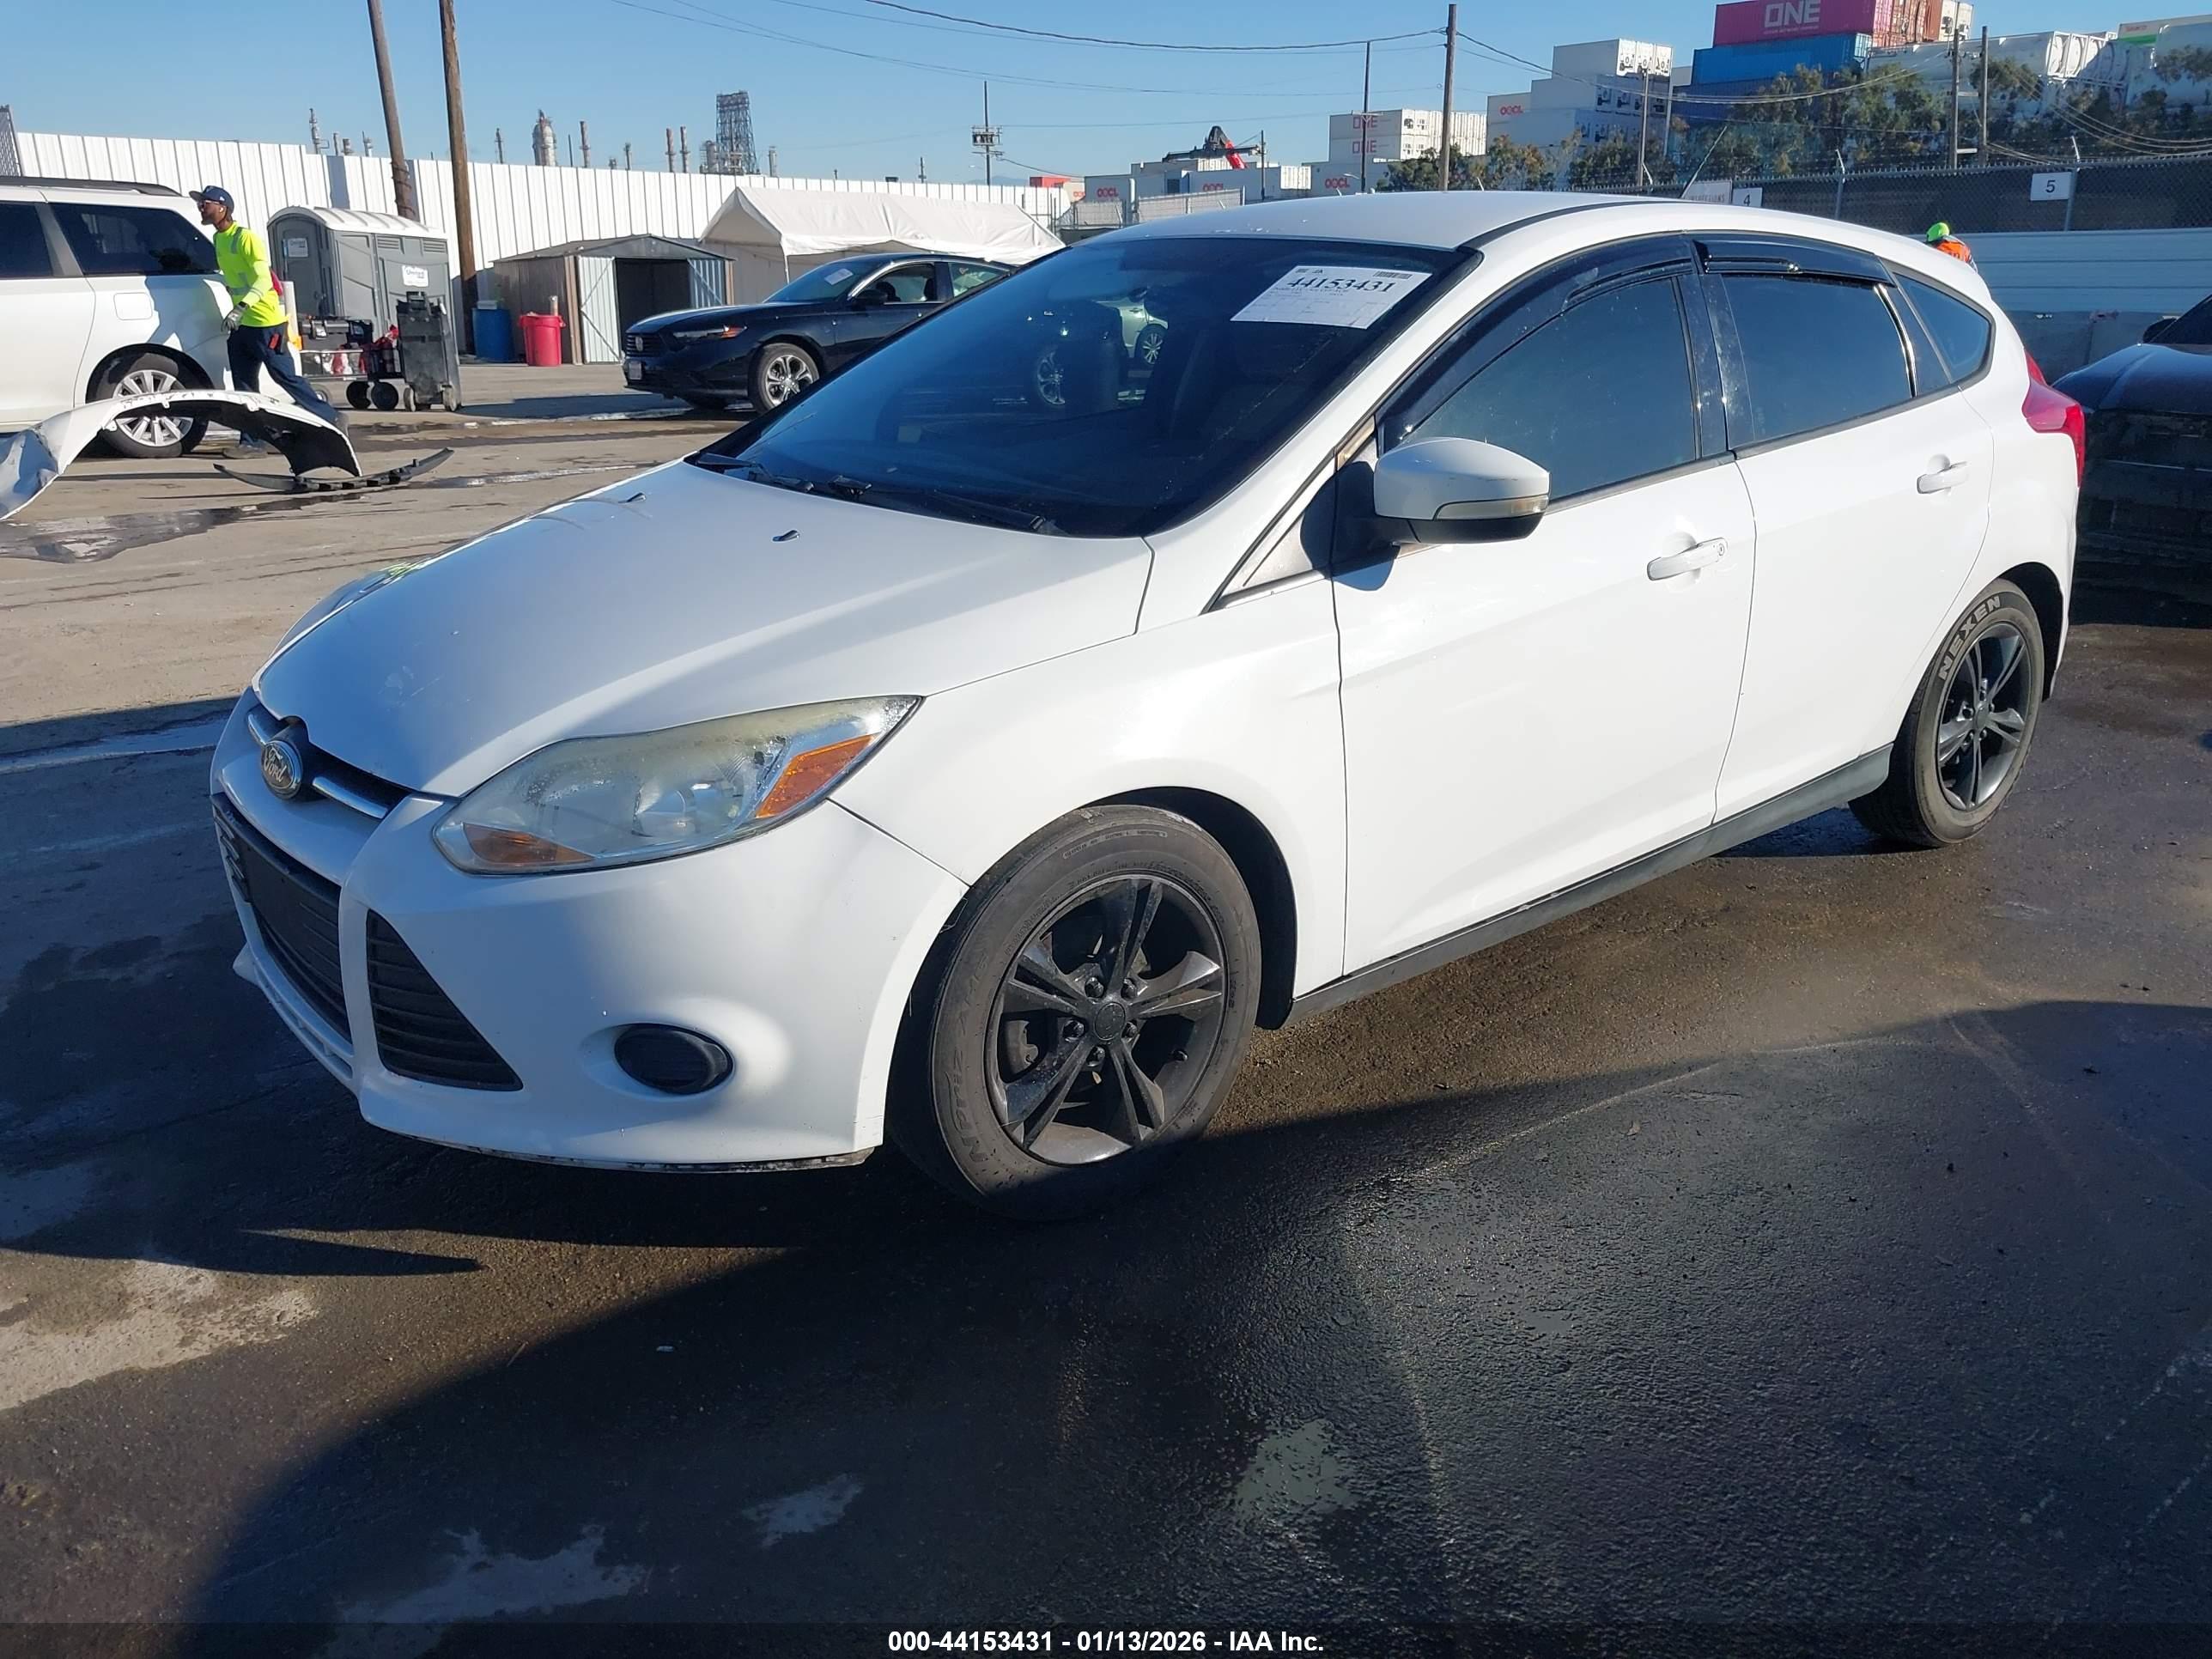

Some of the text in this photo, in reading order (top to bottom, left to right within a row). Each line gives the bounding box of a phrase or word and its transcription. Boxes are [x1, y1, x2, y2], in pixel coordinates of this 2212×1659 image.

[1764, 0, 1820, 27] ONE
[2045, 179, 2056, 193] 5
[1743, 193, 1751, 206] 4
[1287, 276, 1396, 292] 44153431
[1937, 594, 2002, 681] NEXEN
[264, 746, 288, 782] Ford
